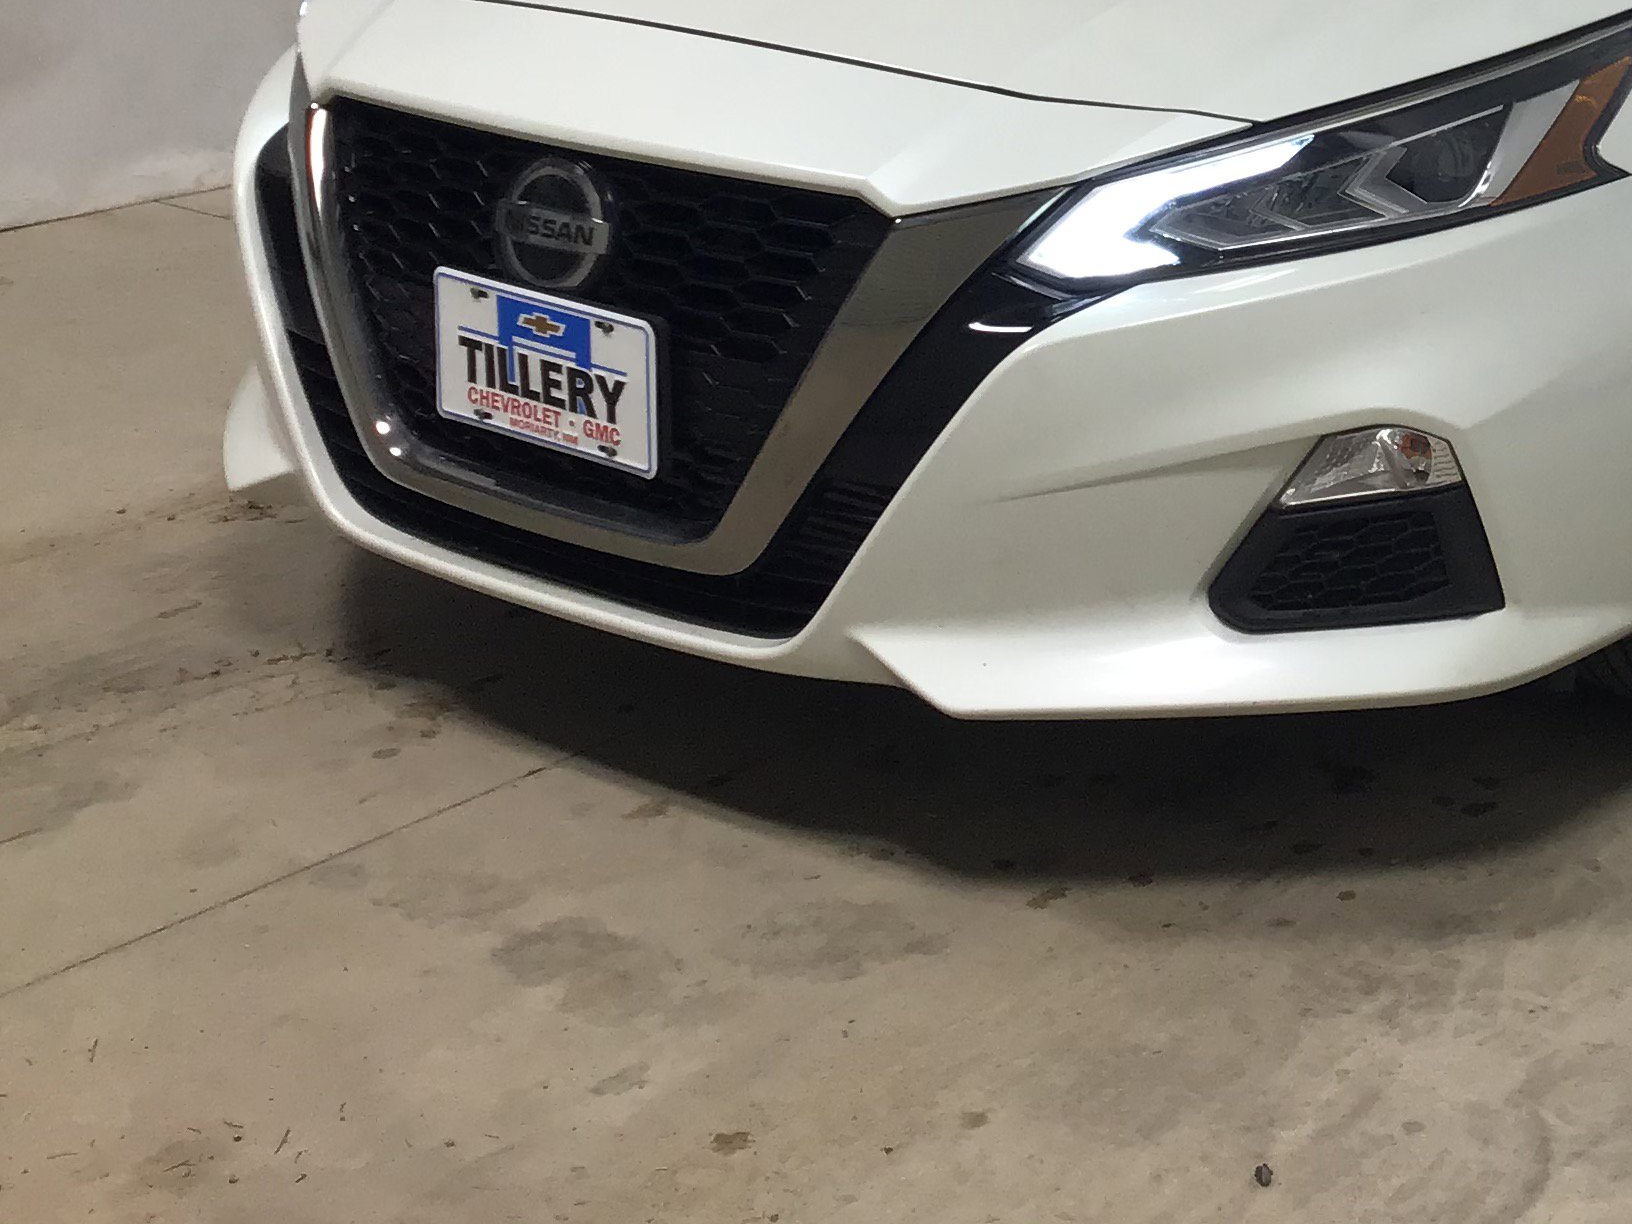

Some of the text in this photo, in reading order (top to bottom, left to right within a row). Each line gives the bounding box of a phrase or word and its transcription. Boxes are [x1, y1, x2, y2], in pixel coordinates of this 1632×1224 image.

[458, 335, 628, 426] TILLERY
[467, 386, 622, 447] CHEVROLET GMC
